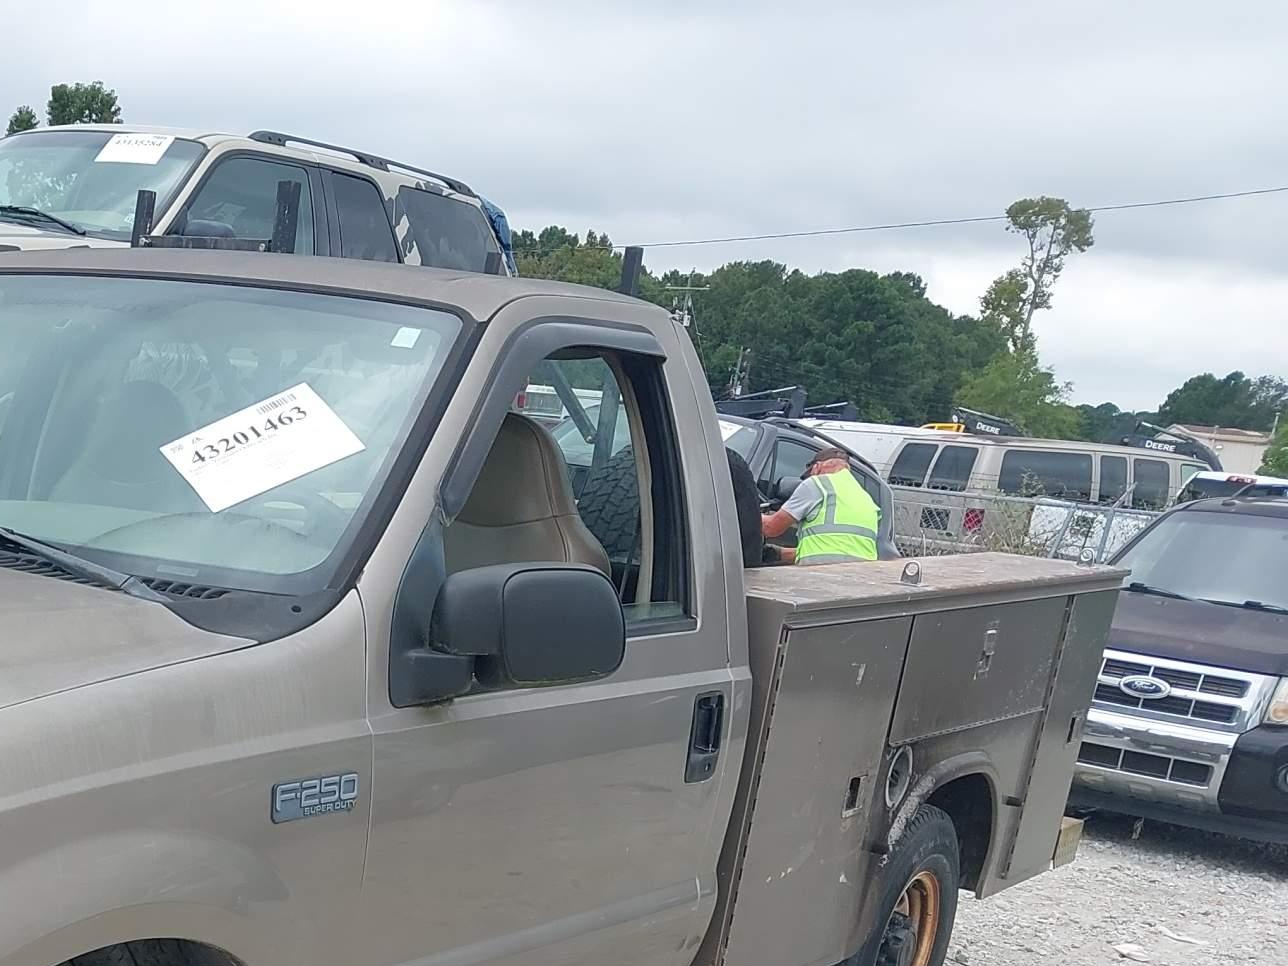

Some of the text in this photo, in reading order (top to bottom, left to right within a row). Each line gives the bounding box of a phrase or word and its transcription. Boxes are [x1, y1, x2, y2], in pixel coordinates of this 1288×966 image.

[191, 405, 308, 465] 43201463
[976, 421, 1001, 435] DEERE
[1145, 439, 1176, 452] DEERE
[304, 799, 357, 815] SUPER DUTY
